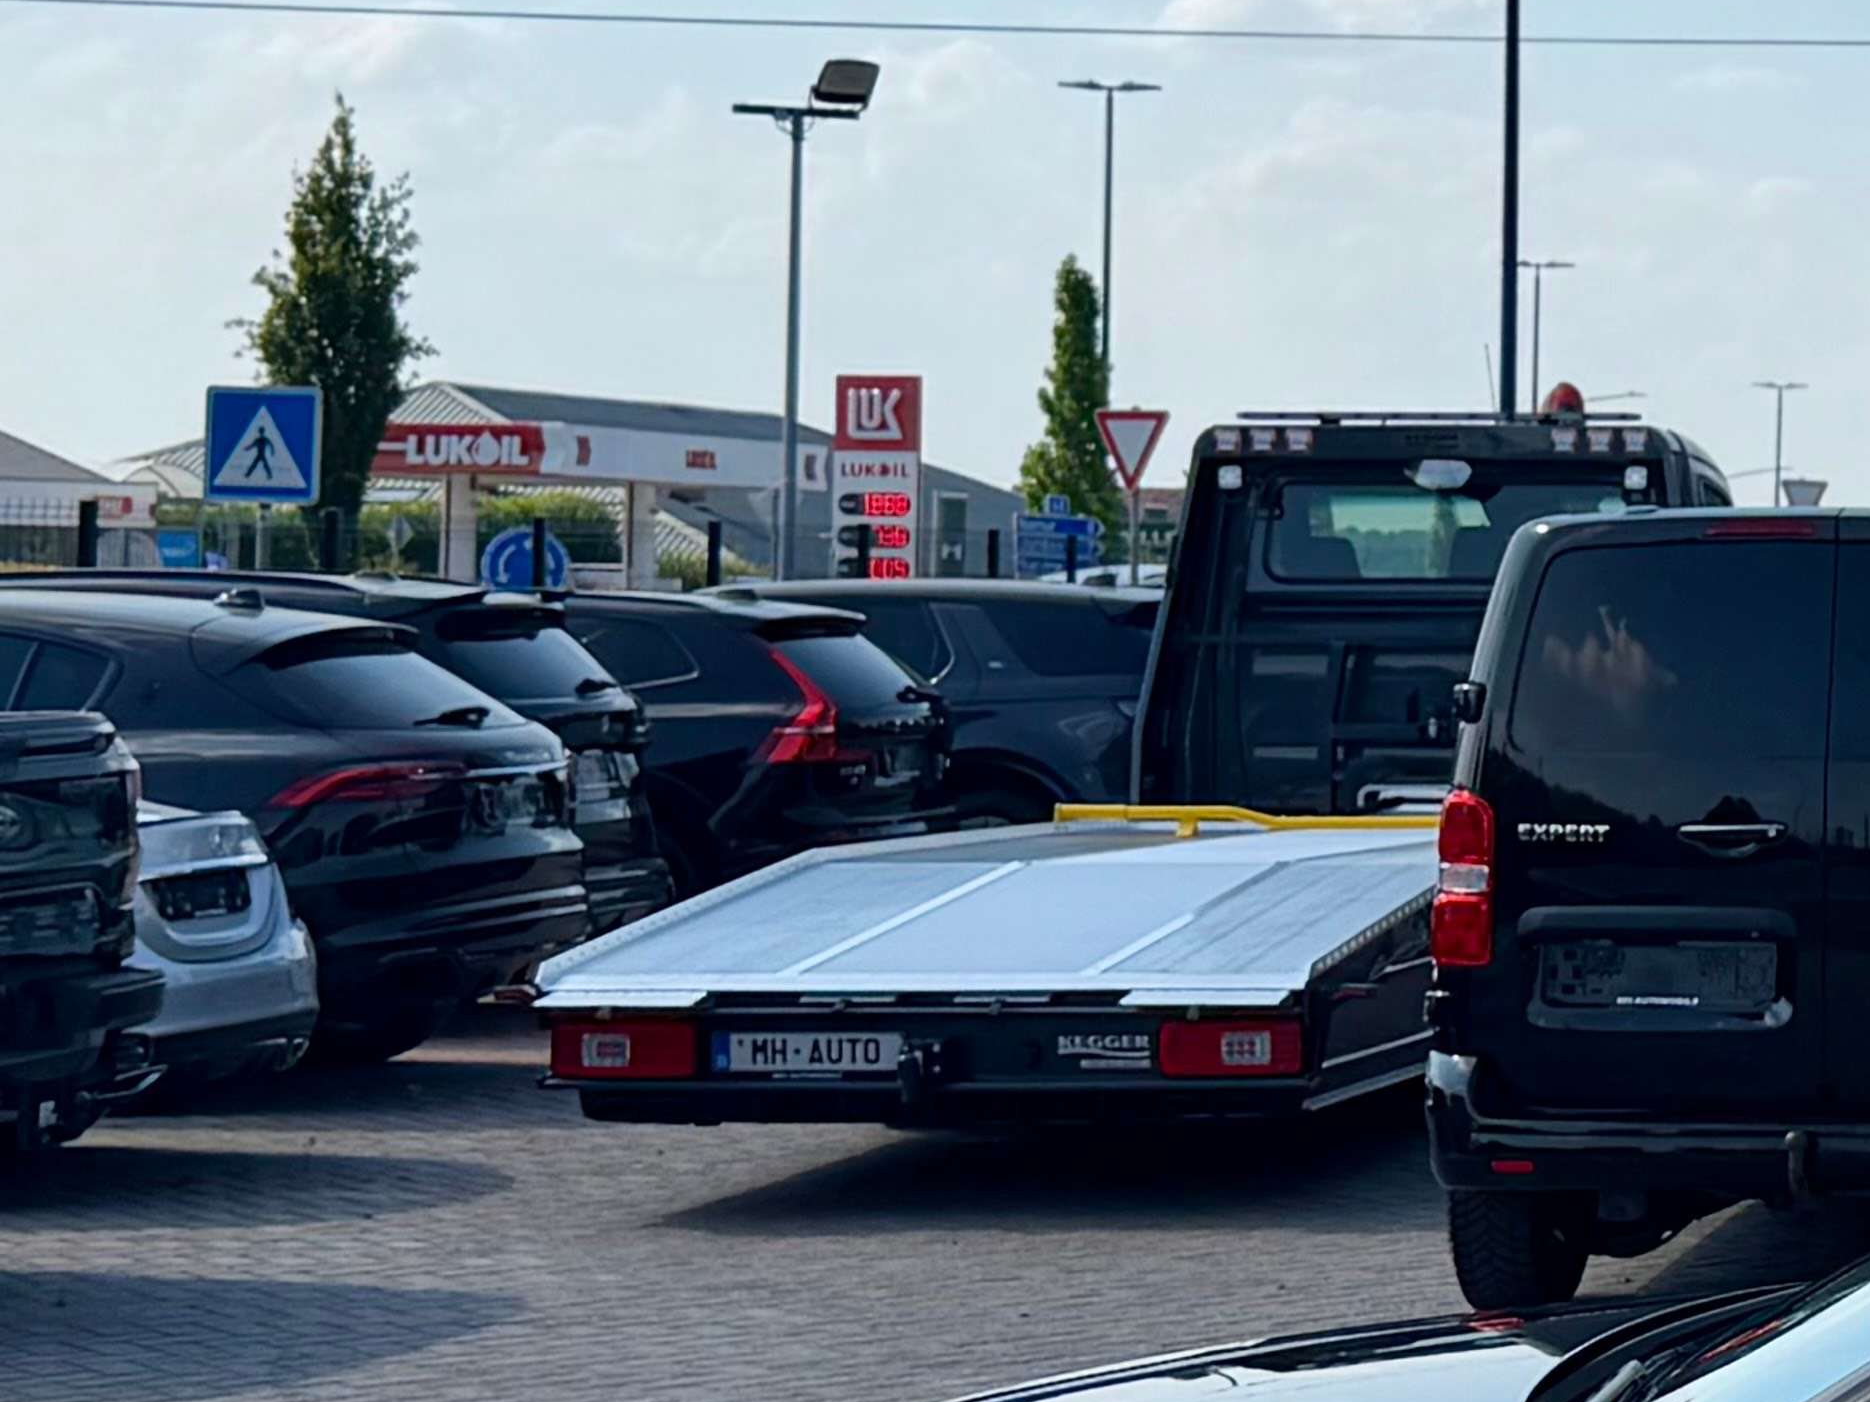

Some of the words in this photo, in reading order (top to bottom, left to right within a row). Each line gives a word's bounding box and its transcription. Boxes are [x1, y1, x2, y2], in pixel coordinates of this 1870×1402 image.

[405, 429, 530, 466] LUKOIL
[841, 462, 908, 477] LUKOIL
[1518, 823, 1610, 842] EXPERT
